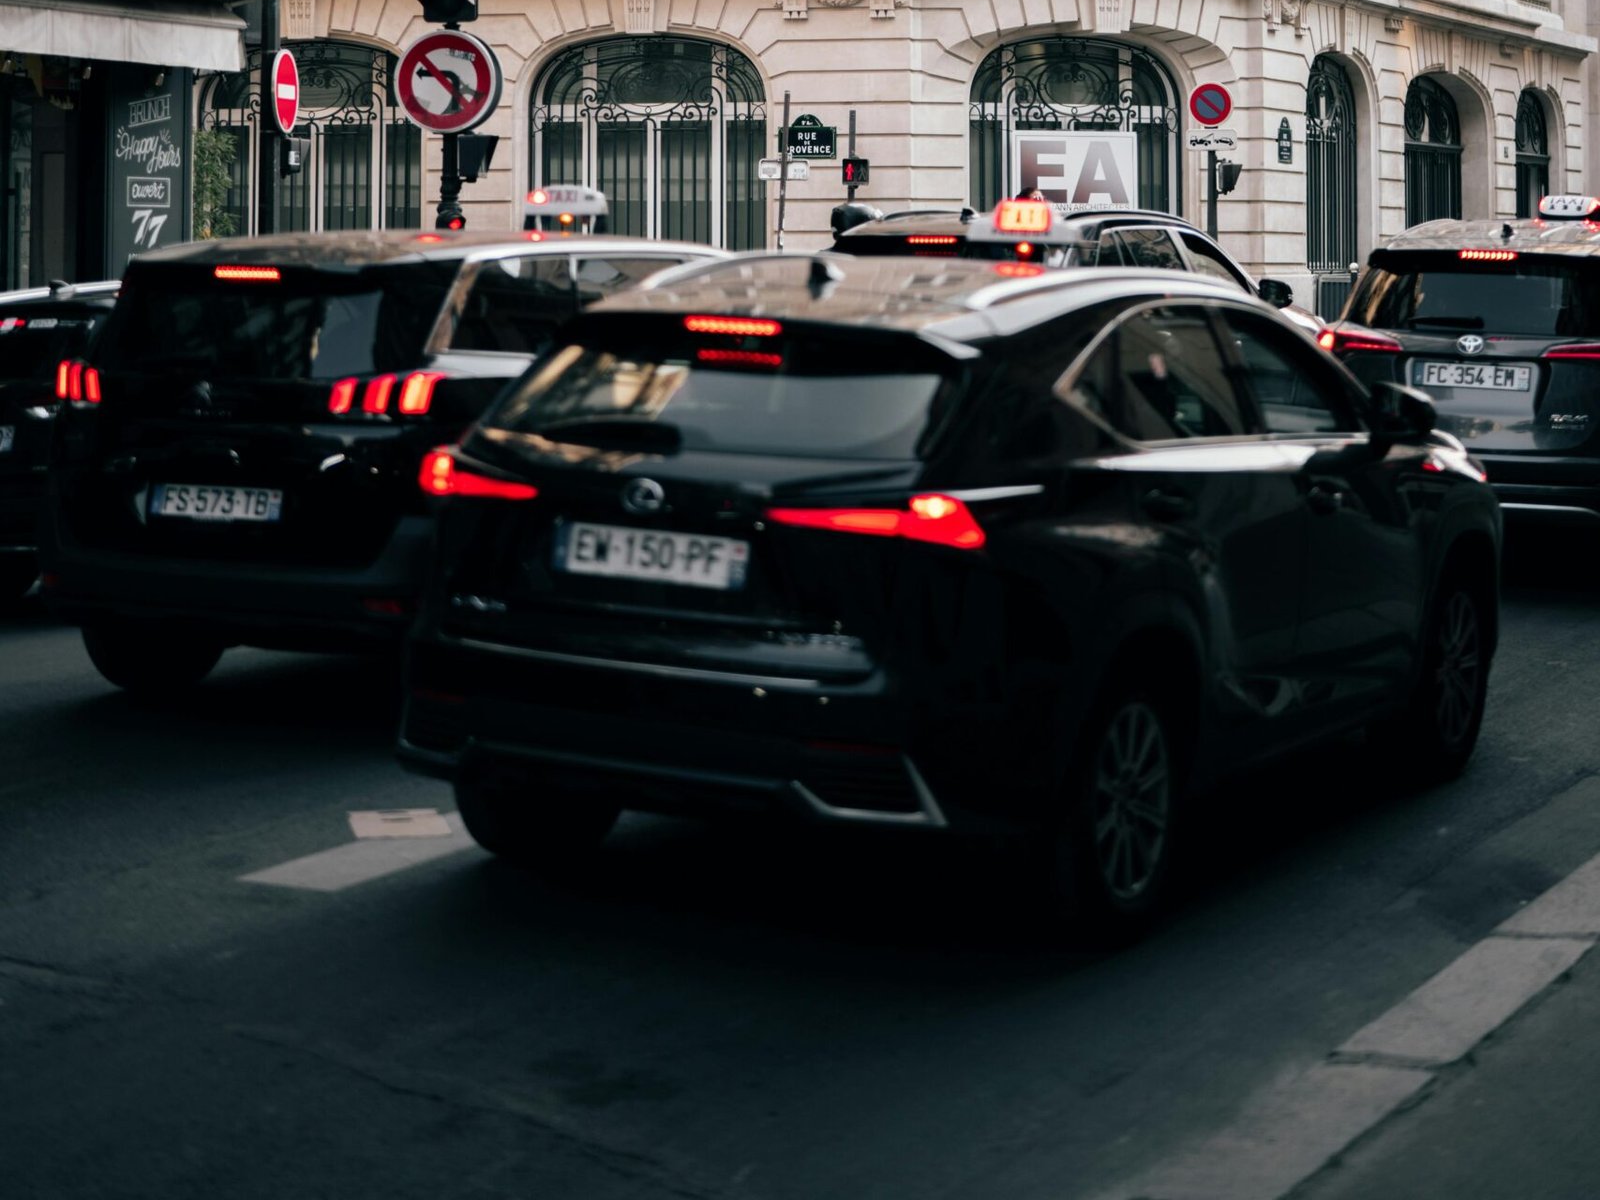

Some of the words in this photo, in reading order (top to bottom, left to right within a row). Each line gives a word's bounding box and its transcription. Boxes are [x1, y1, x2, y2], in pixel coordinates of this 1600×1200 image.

[129, 97, 170, 124] BRUNCH
[797, 132, 817, 141] RUE
[116, 132, 159, 163] Happy
[147, 143, 181, 174] Hours
[1020, 140, 1130, 204] EA
[1426, 365, 1514, 387] FC-354-EM
